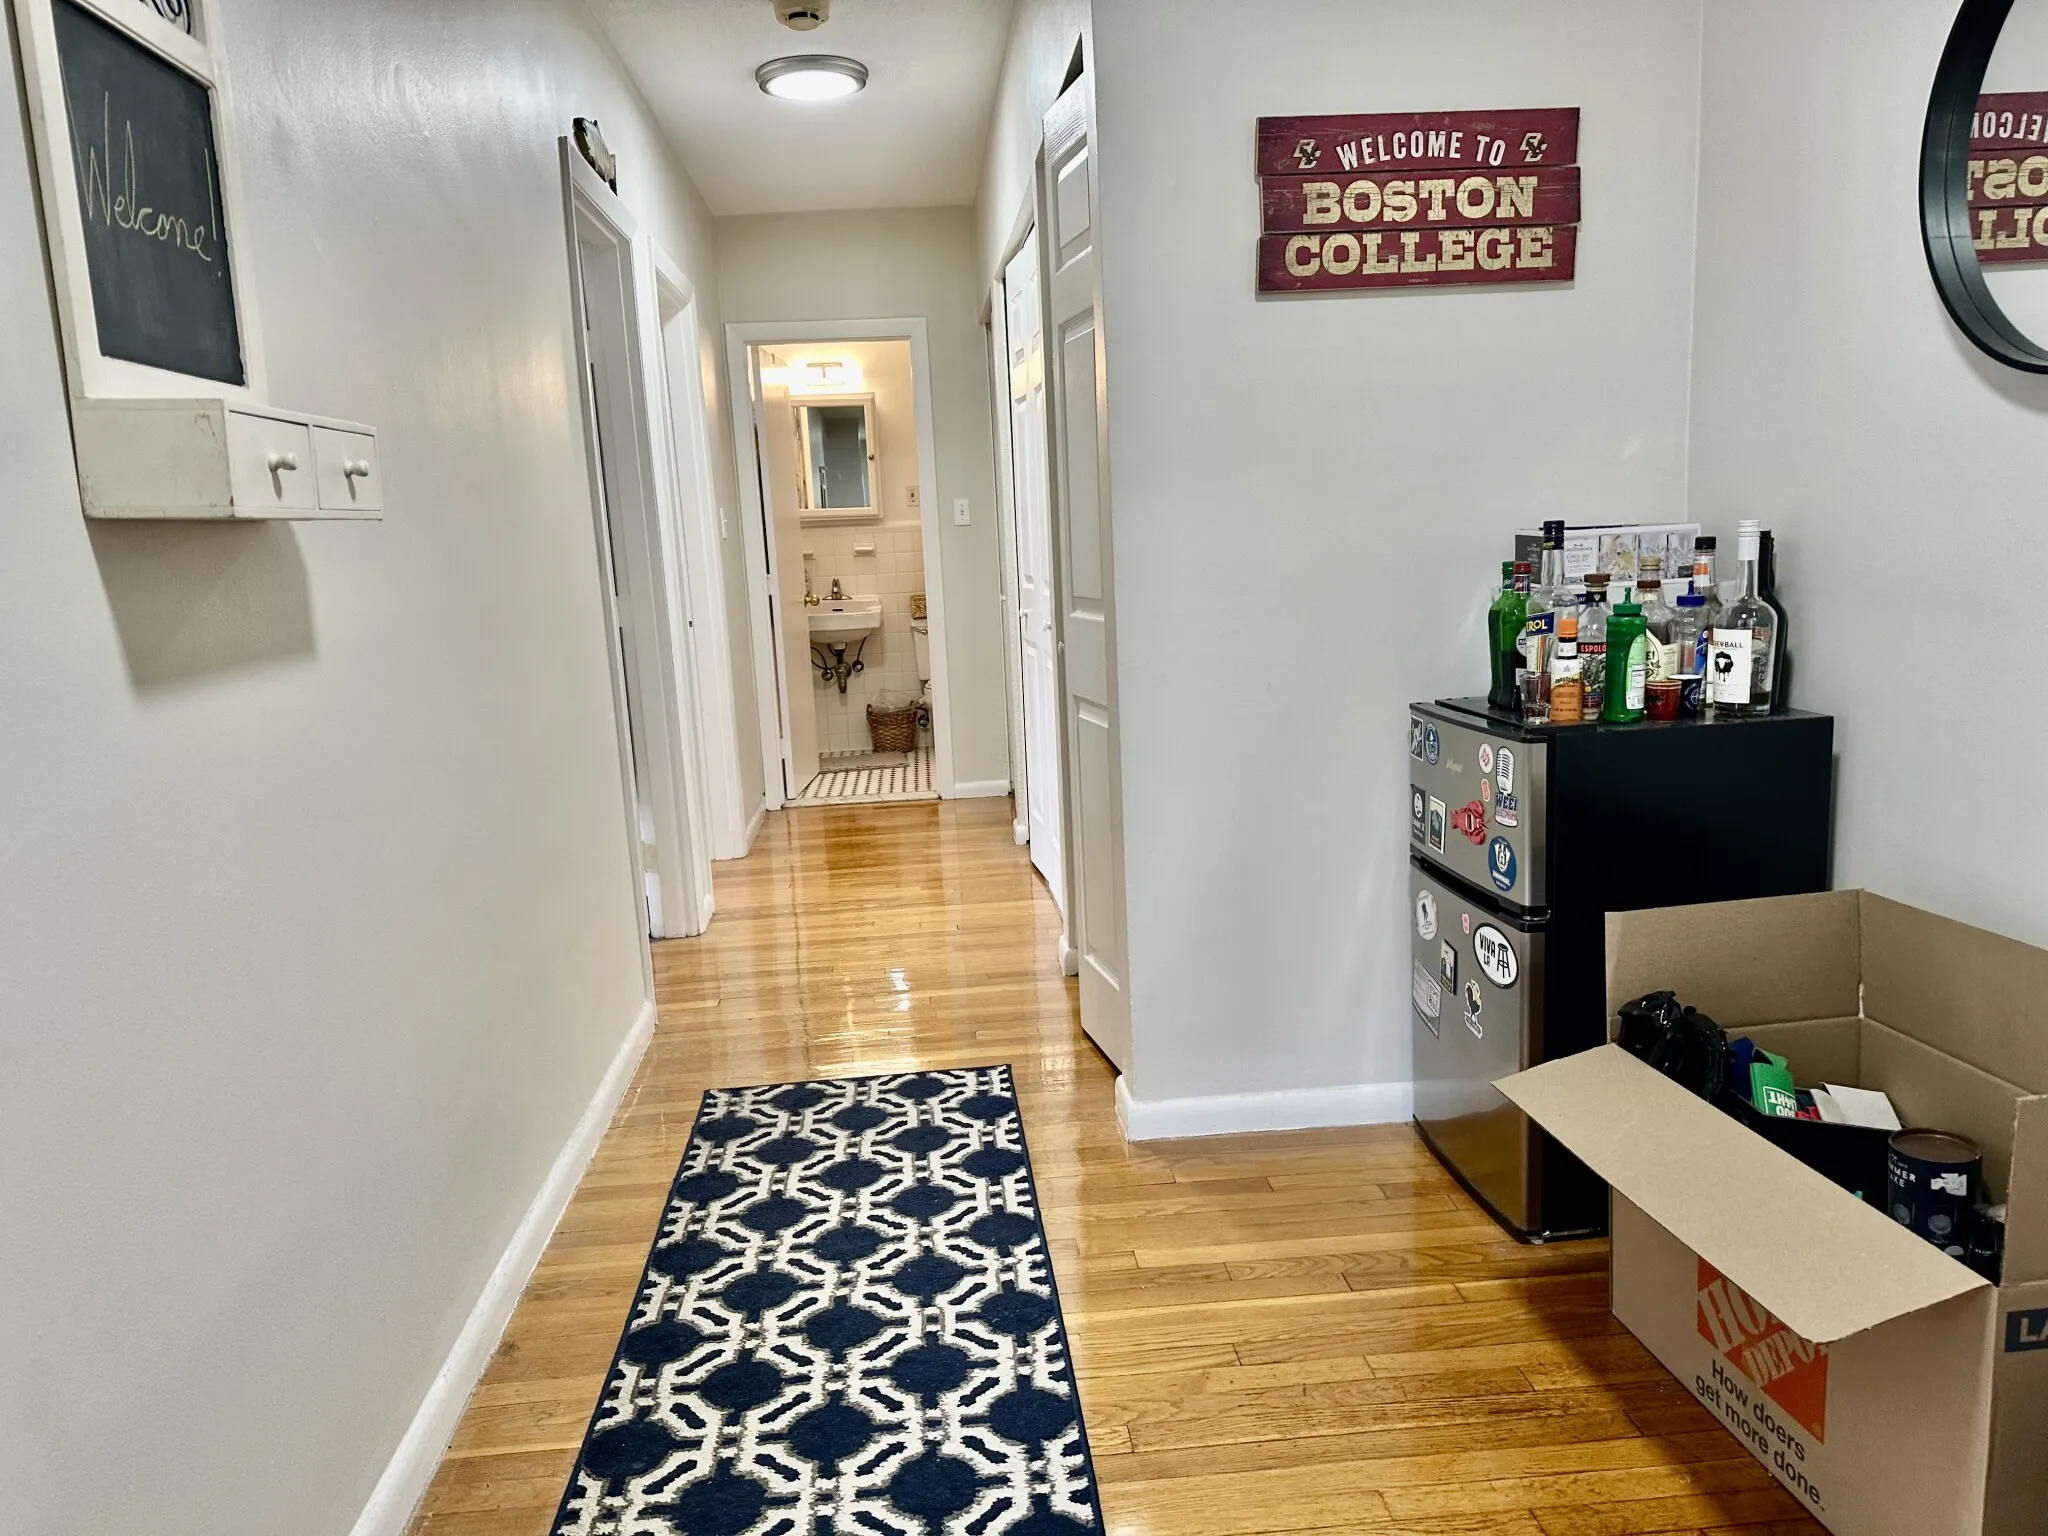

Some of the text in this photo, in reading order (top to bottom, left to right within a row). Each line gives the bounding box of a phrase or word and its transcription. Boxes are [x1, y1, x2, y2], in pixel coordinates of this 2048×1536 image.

[1336, 130, 1506, 171] WELCOME TO
[1302, 175, 1538, 225] BOSTON
[1285, 226, 1554, 277] COLLEGE
[1480, 932, 1496, 958] VIVA
[1711, 1358, 1805, 1461] How doers
[1695, 1374, 1825, 1512] get more done.
